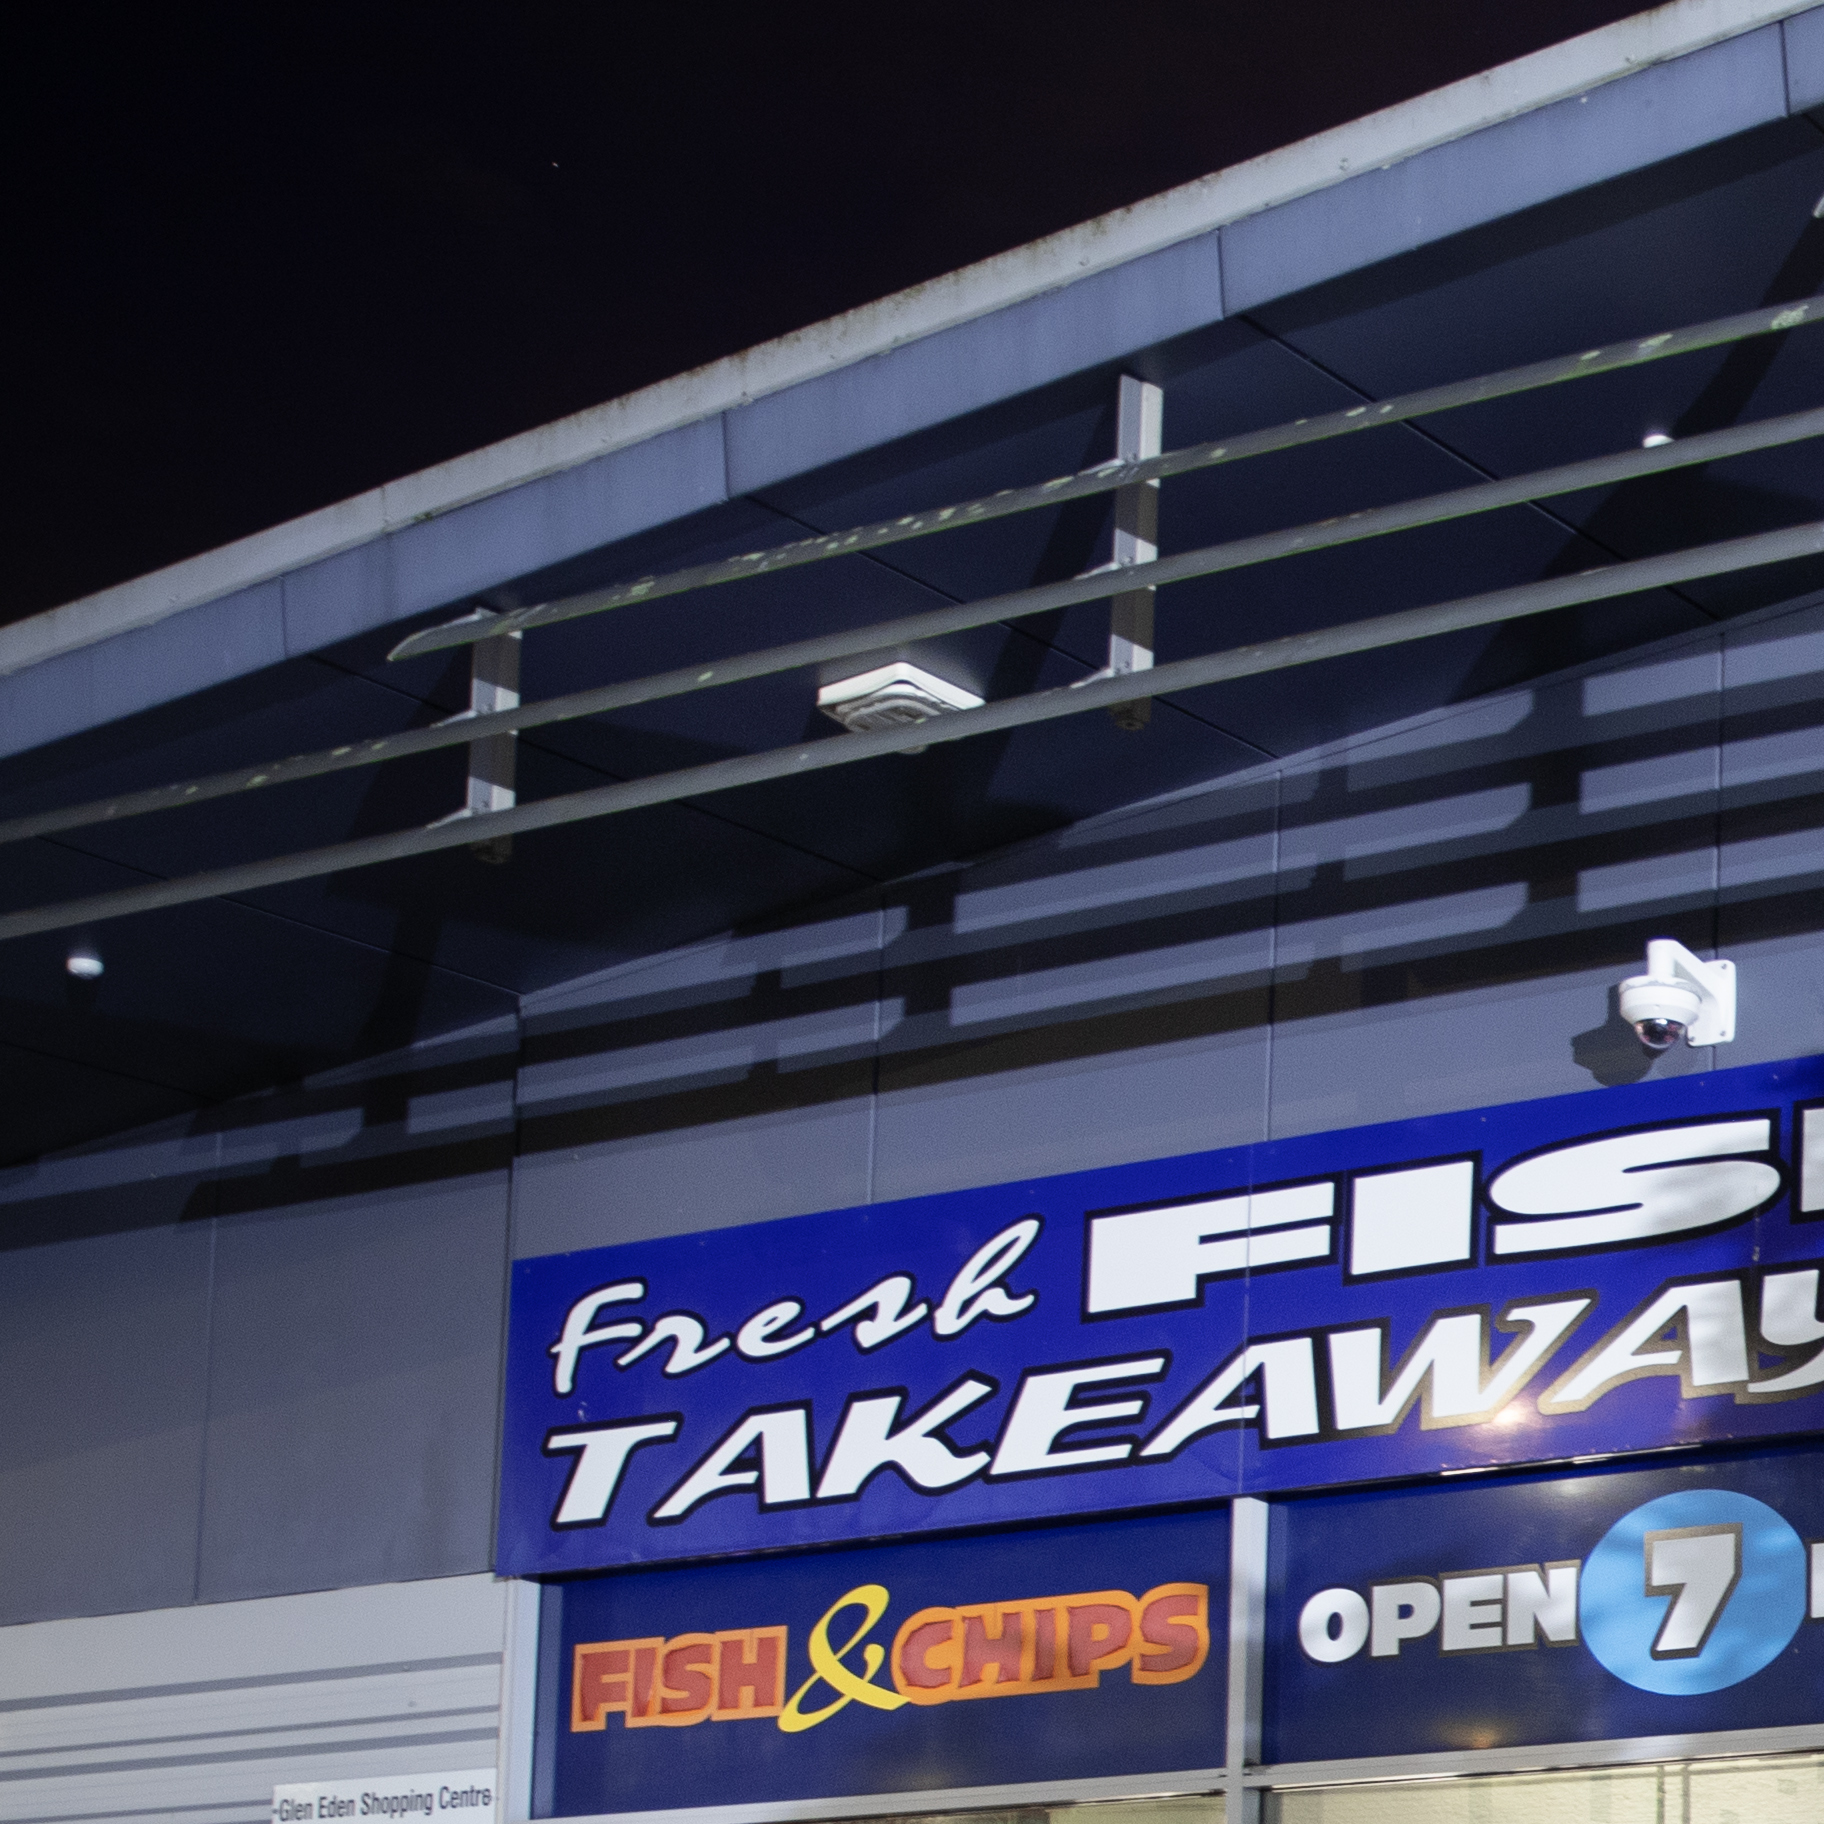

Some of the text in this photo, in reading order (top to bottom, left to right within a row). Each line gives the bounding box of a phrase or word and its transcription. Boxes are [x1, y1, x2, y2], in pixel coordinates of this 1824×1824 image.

[551, 1219, 1040, 1391] Fresh
[1299, 1560, 1578, 1663] OPEN
[1644, 1524, 1742, 1659] 7
[279, 1785, 493, 1822] Glen Eden Shopping Centre
